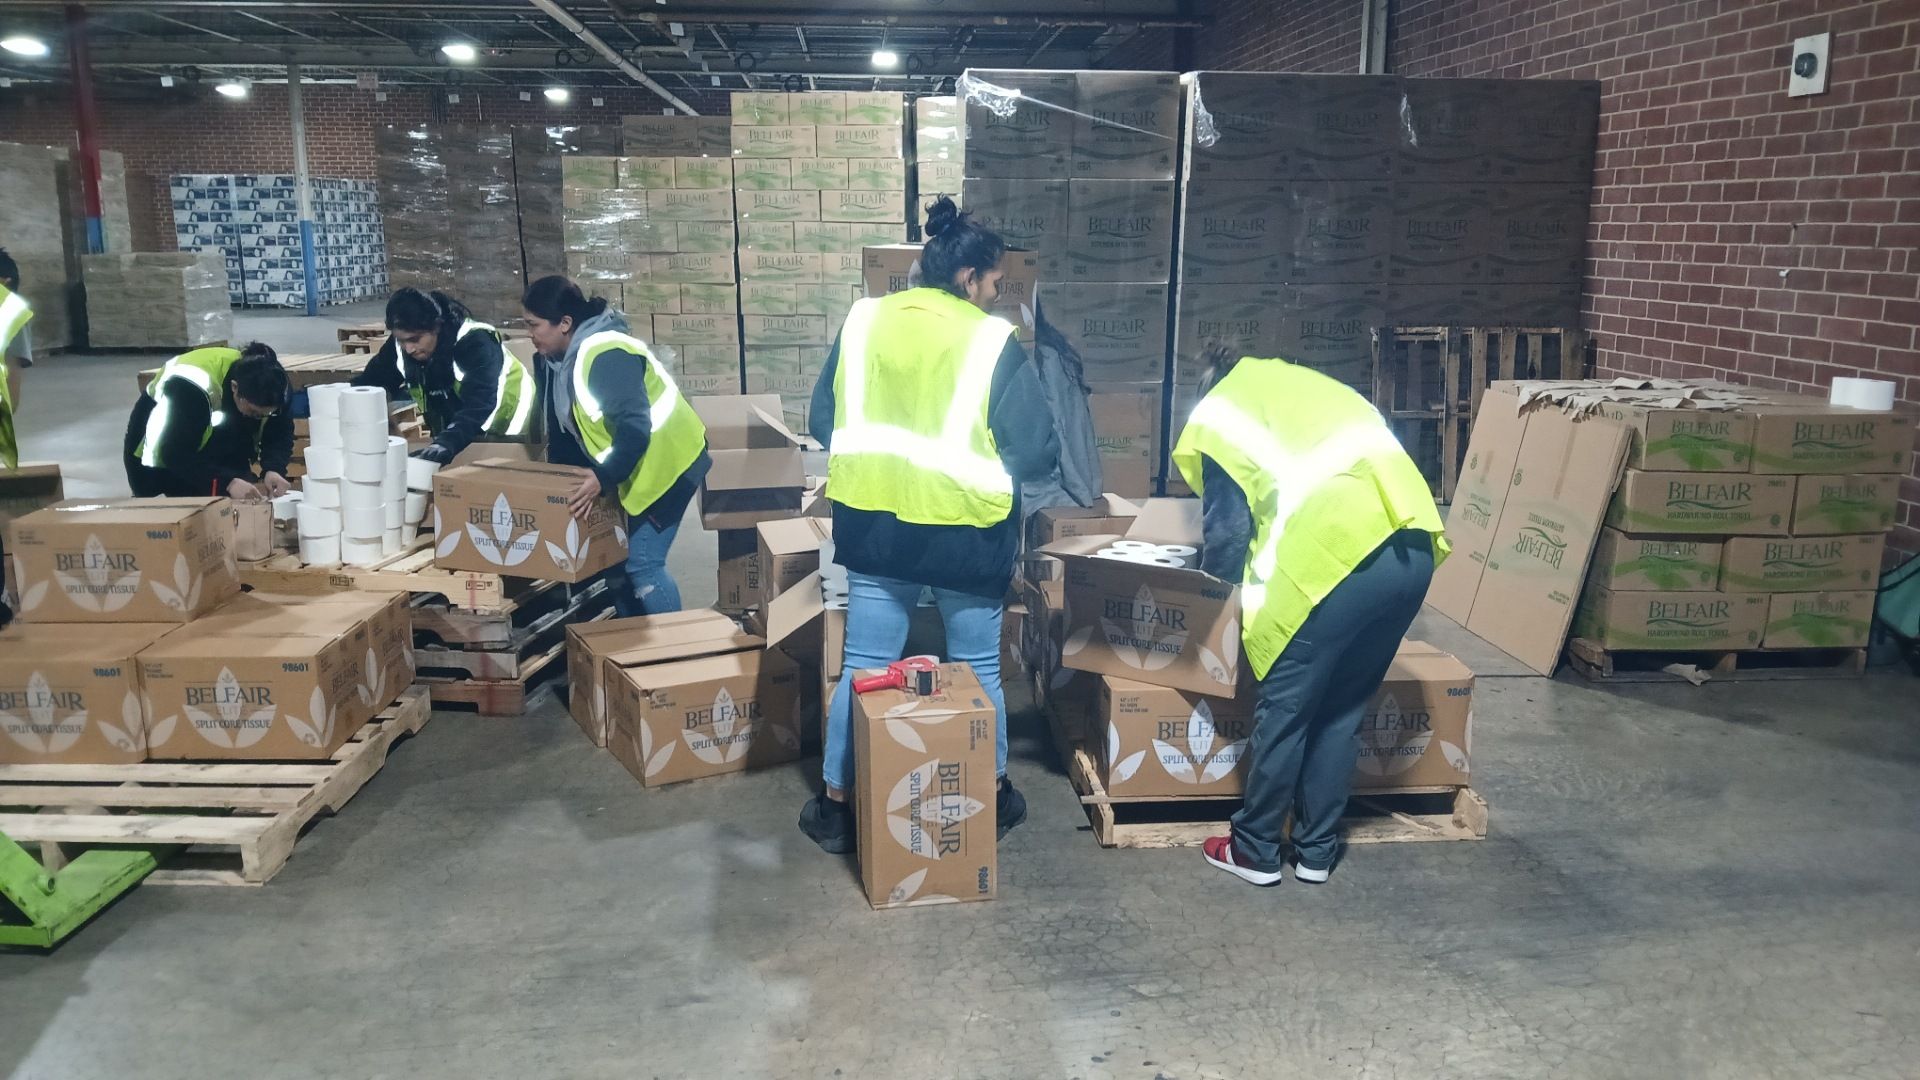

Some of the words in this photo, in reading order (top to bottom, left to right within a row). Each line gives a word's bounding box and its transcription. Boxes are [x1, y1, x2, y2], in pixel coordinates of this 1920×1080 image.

[1793, 422, 1876, 441] BELFAIR
[1667, 481, 1752, 501] BELFAIR
[469, 507, 539, 531] BELFAIR
[146, 530, 173, 540] 98601
[475, 536, 491, 547] SPLIT
[1764, 541, 1844, 561] BELFAIR
[55, 553, 139, 571] BELFAIR
[66, 584, 87, 594] SPLIT
[110, 584, 137, 594] TISSUE
[1104, 599, 1187, 631] BELFAIR
[1649, 601, 1730, 619] BELFAIR
[1109, 634, 1130, 645] SPLIT
[1153, 640, 1183, 655] TISSUE
[93, 667, 121, 677] 98601
[282, 662, 309, 672] 98601
[0, 691, 86, 711] BELFAIR
[185, 687, 275, 706] BELFAIR
[195, 719, 217, 729] SPLIT
[241, 719, 272, 729] TISSUE
[685, 702, 764, 730] BELFAIR
[1361, 711, 1433, 732] ELFAIR
[8, 725, 29, 734] SPLIT
[53, 725, 83, 734] TISSUE
[1158, 720, 1246, 741] BELFAIR
[692, 740, 712, 751] SPLIT
[1162, 754, 1184, 764] SPLIT
[1211, 753, 1240, 764] TISSUE
[910, 771, 921, 796] SPLIT
[938, 762, 961, 858] BELFAIR
[910, 825, 922, 854] TISSUE
[978, 866, 989, 895] 98601
